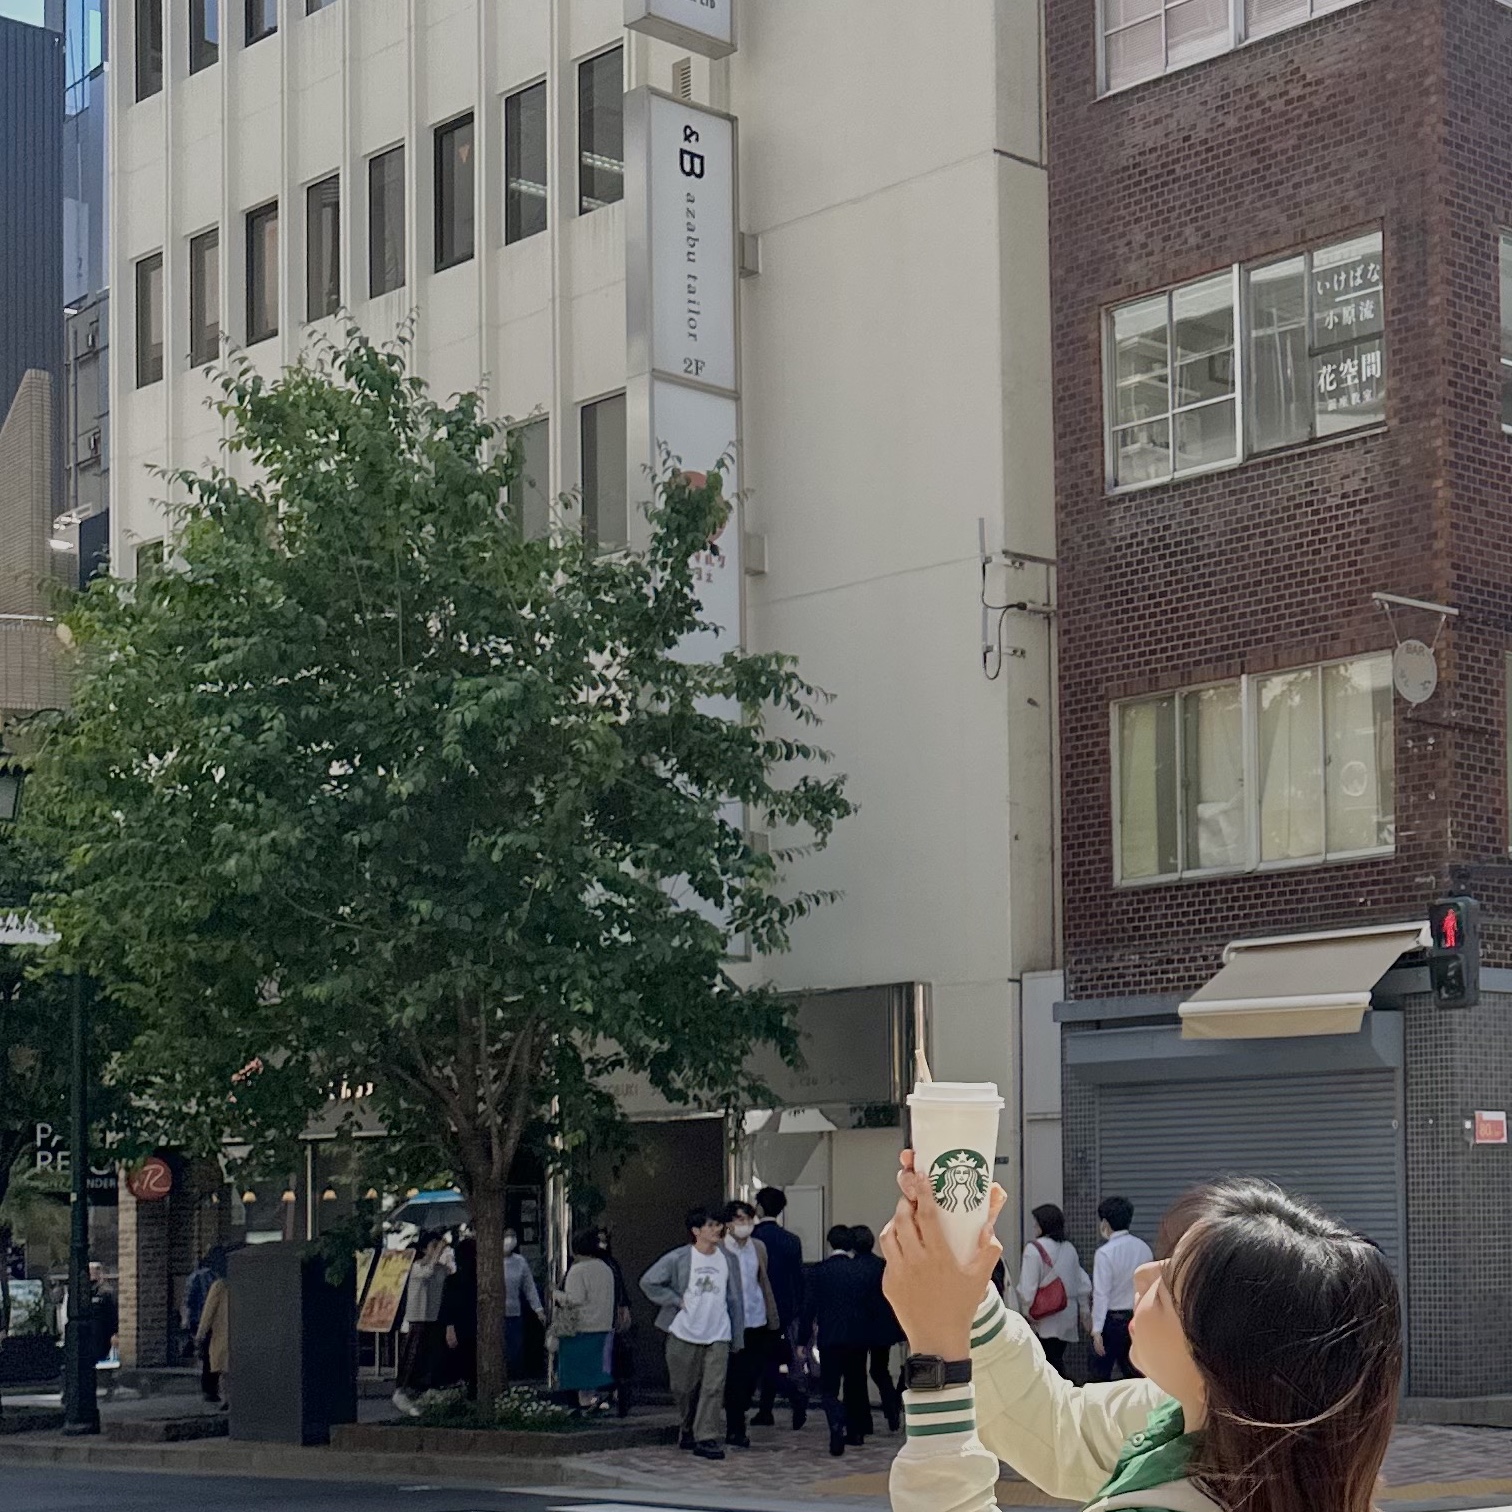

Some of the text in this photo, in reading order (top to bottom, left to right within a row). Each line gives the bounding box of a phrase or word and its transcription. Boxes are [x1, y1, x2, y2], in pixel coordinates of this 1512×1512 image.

[686, 192, 700, 263] azabu
[1317, 262, 1381, 295] いけばな
[687, 273, 701, 342] tailor
[1325, 300, 1375, 330] 小原流
[683, 357, 705, 376] 2F
[1318, 350, 1382, 393] 花空間
